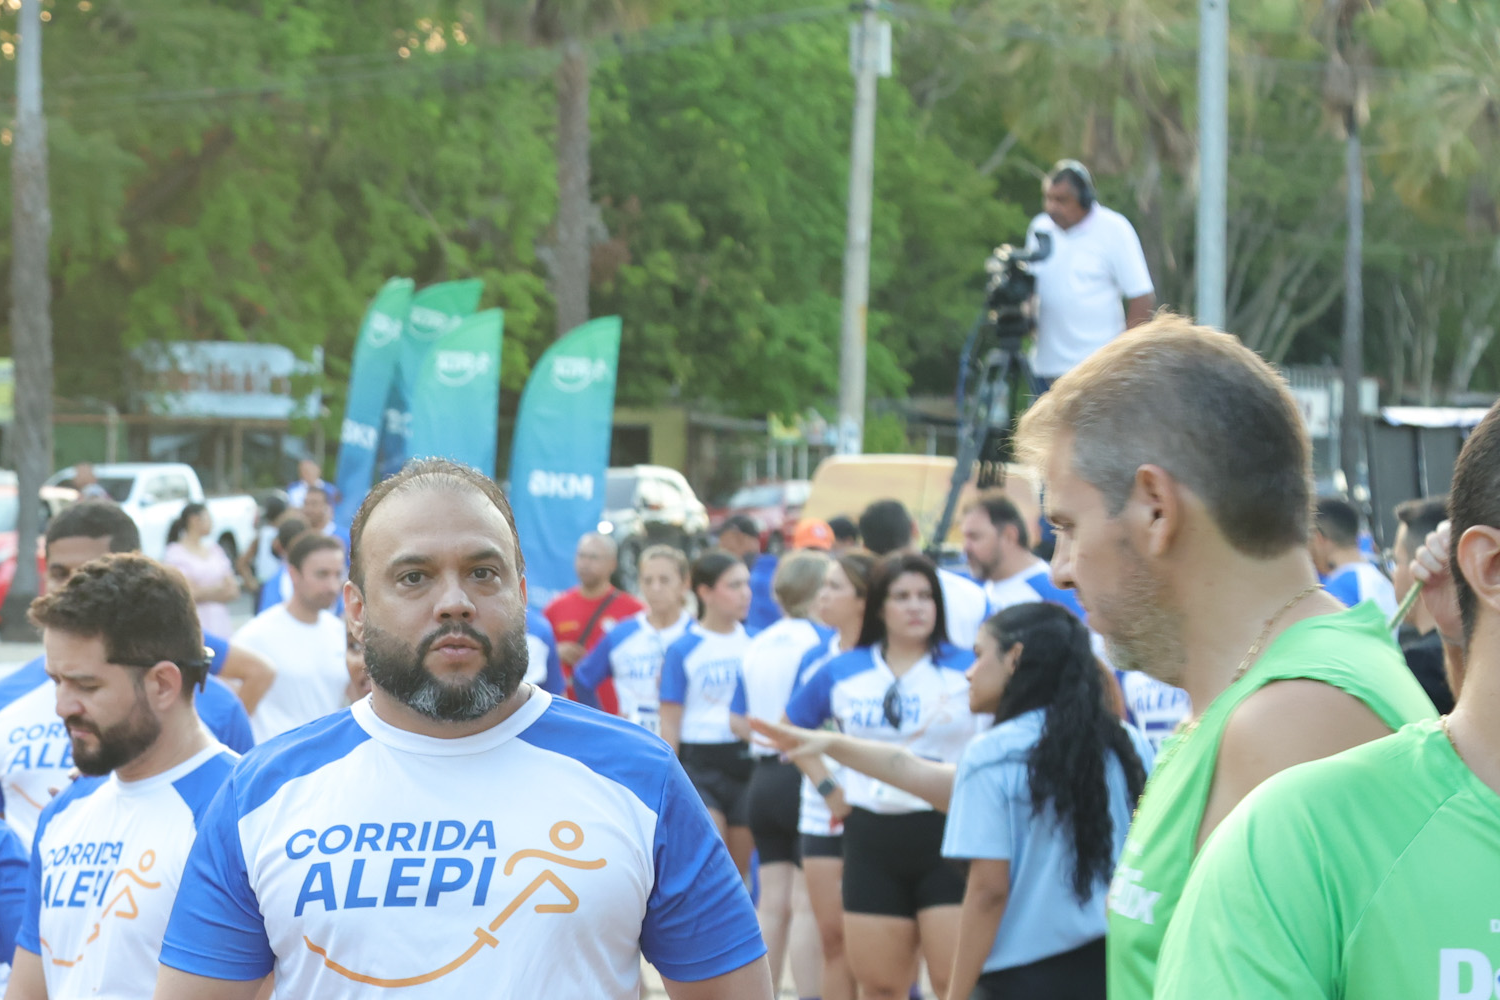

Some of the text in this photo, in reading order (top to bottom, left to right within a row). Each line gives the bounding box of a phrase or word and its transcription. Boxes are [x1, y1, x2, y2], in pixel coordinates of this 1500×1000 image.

[528, 470, 594, 500] 8KM
[9, 722, 68, 744] COR
[285, 819, 497, 860] CORRIDA
[43, 841, 123, 871] CORRIDA
[293, 857, 497, 918] ALEPI
